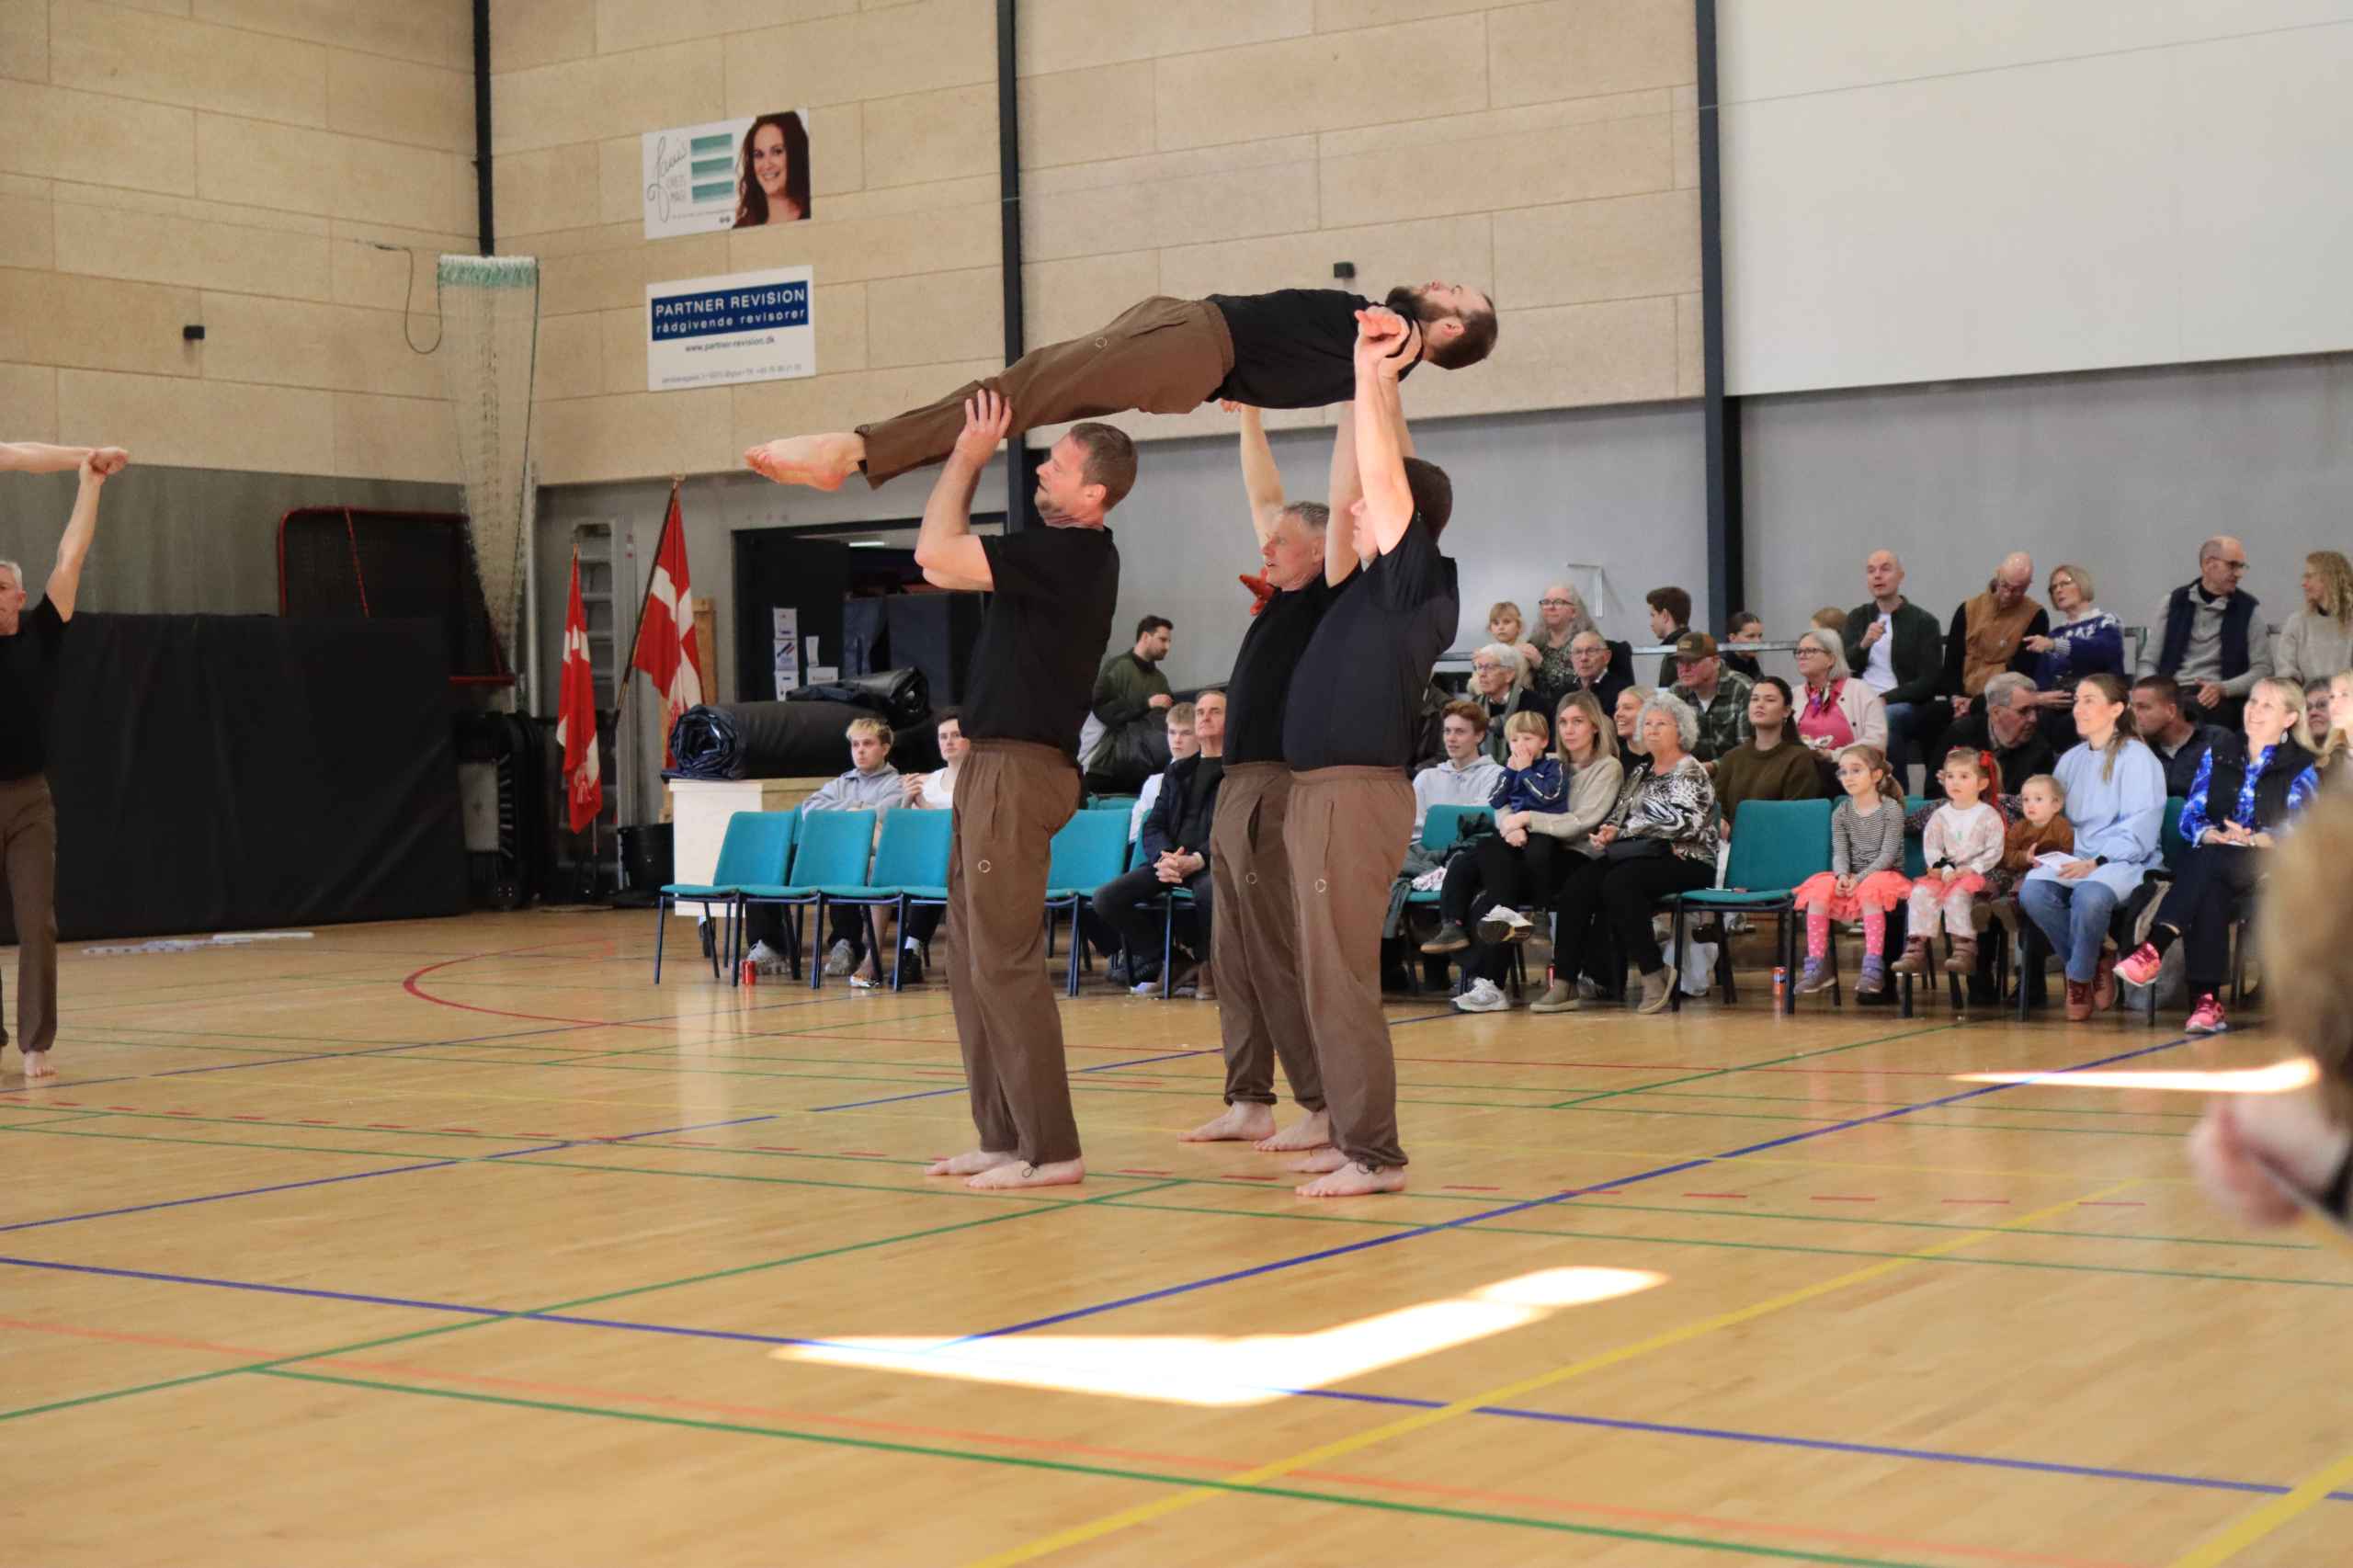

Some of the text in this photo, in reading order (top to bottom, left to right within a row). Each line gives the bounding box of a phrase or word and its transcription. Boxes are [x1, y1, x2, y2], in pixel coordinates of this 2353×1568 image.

[655, 289, 805, 316] PARTNER REVISION
[656, 309, 805, 334] rådgivende revisorer
